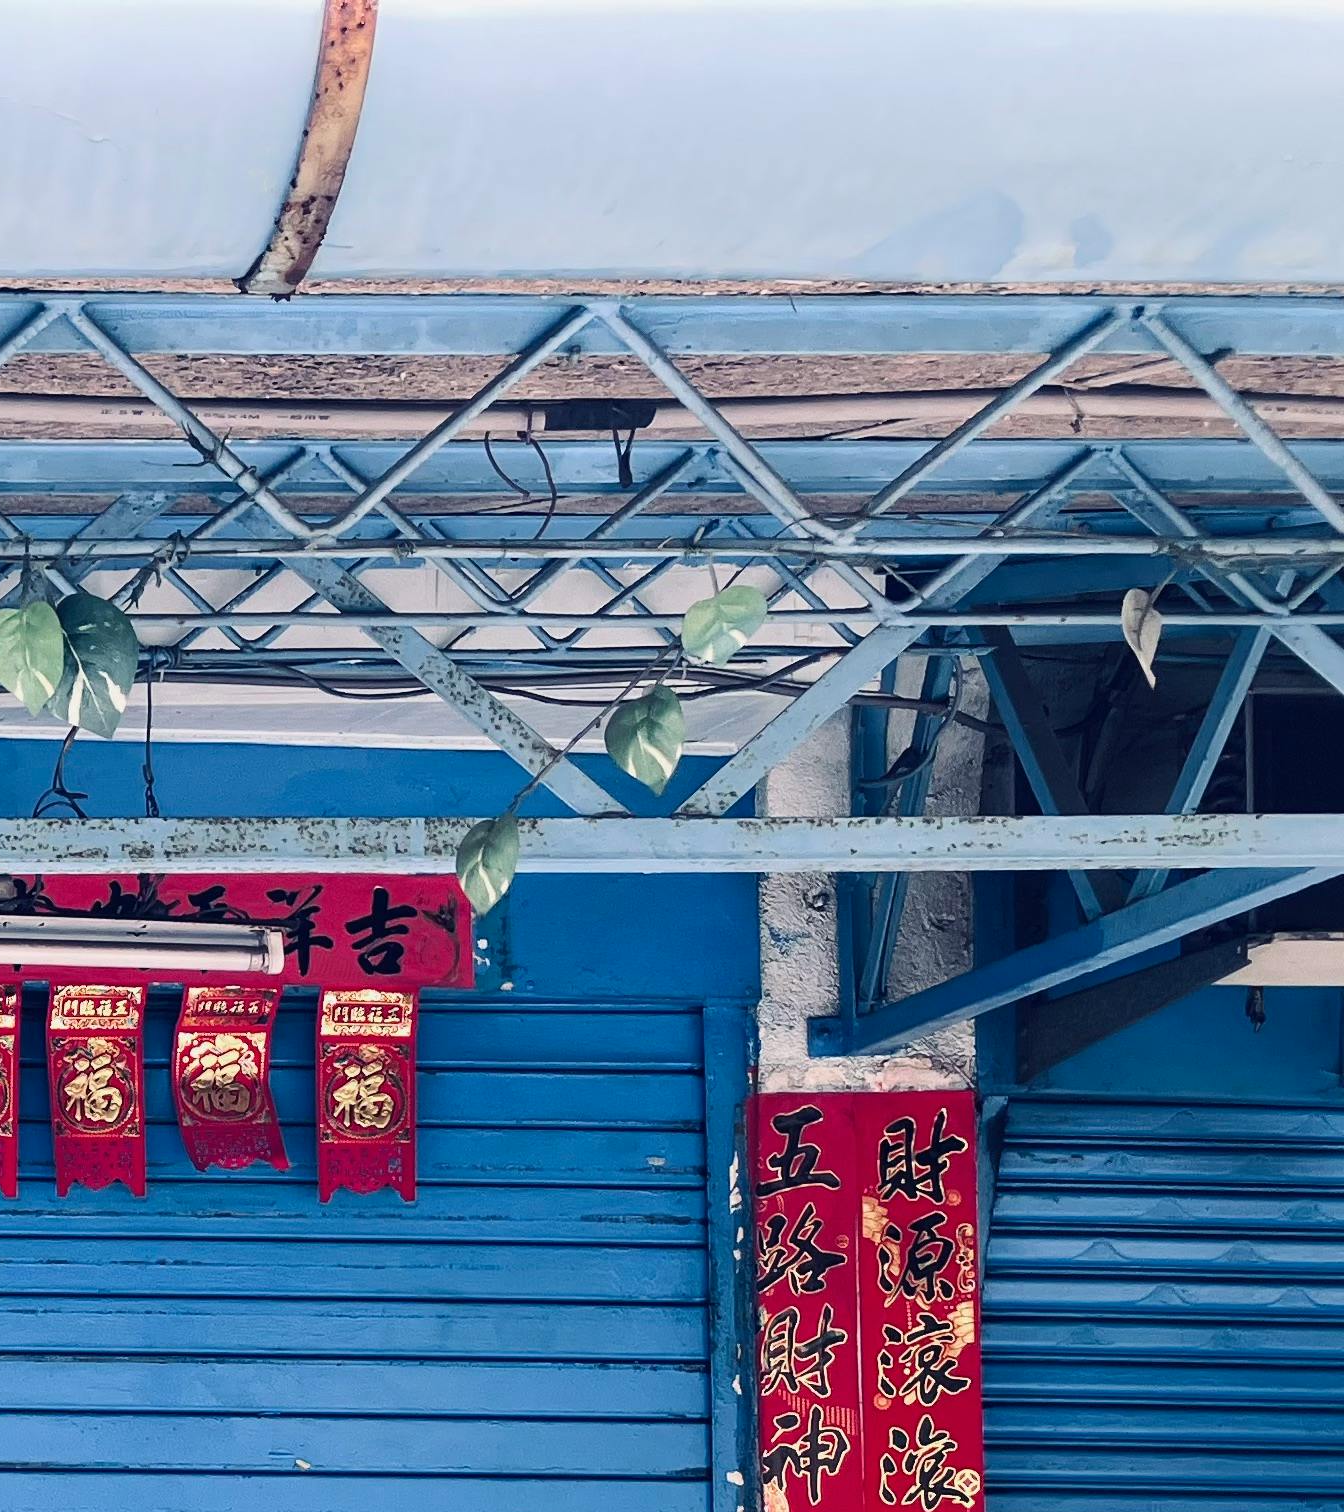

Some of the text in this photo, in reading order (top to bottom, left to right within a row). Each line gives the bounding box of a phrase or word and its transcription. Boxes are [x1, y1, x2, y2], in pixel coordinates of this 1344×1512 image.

[64, 1053, 124, 1122] 福
[192, 1051, 251, 1114] 福
[334, 1060, 394, 1129] 福
